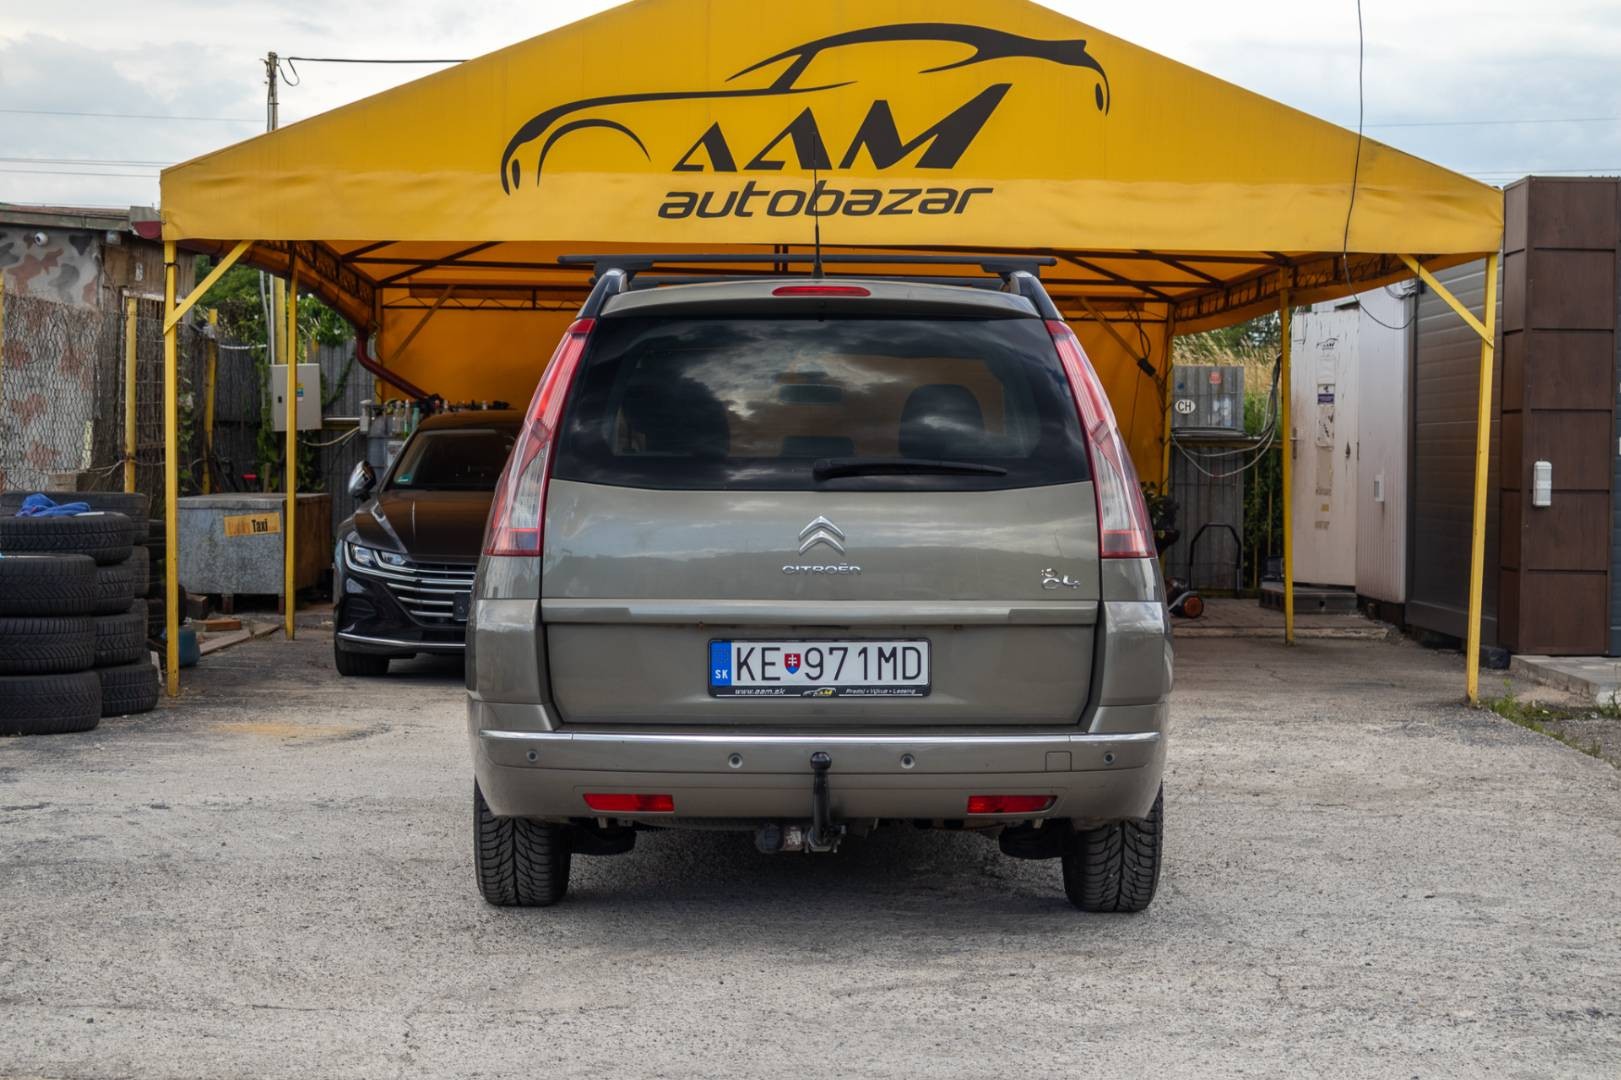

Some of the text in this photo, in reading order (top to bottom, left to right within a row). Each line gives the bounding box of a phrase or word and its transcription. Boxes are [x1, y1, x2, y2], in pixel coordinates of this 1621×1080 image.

[672, 83, 1013, 172] AAM
[657, 180, 994, 219] autobazar
[1177, 401, 1192, 412] CH
[251, 518, 268, 533] Taxi
[715, 669, 728, 680] SK
[736, 646, 922, 681] KE 971MD
